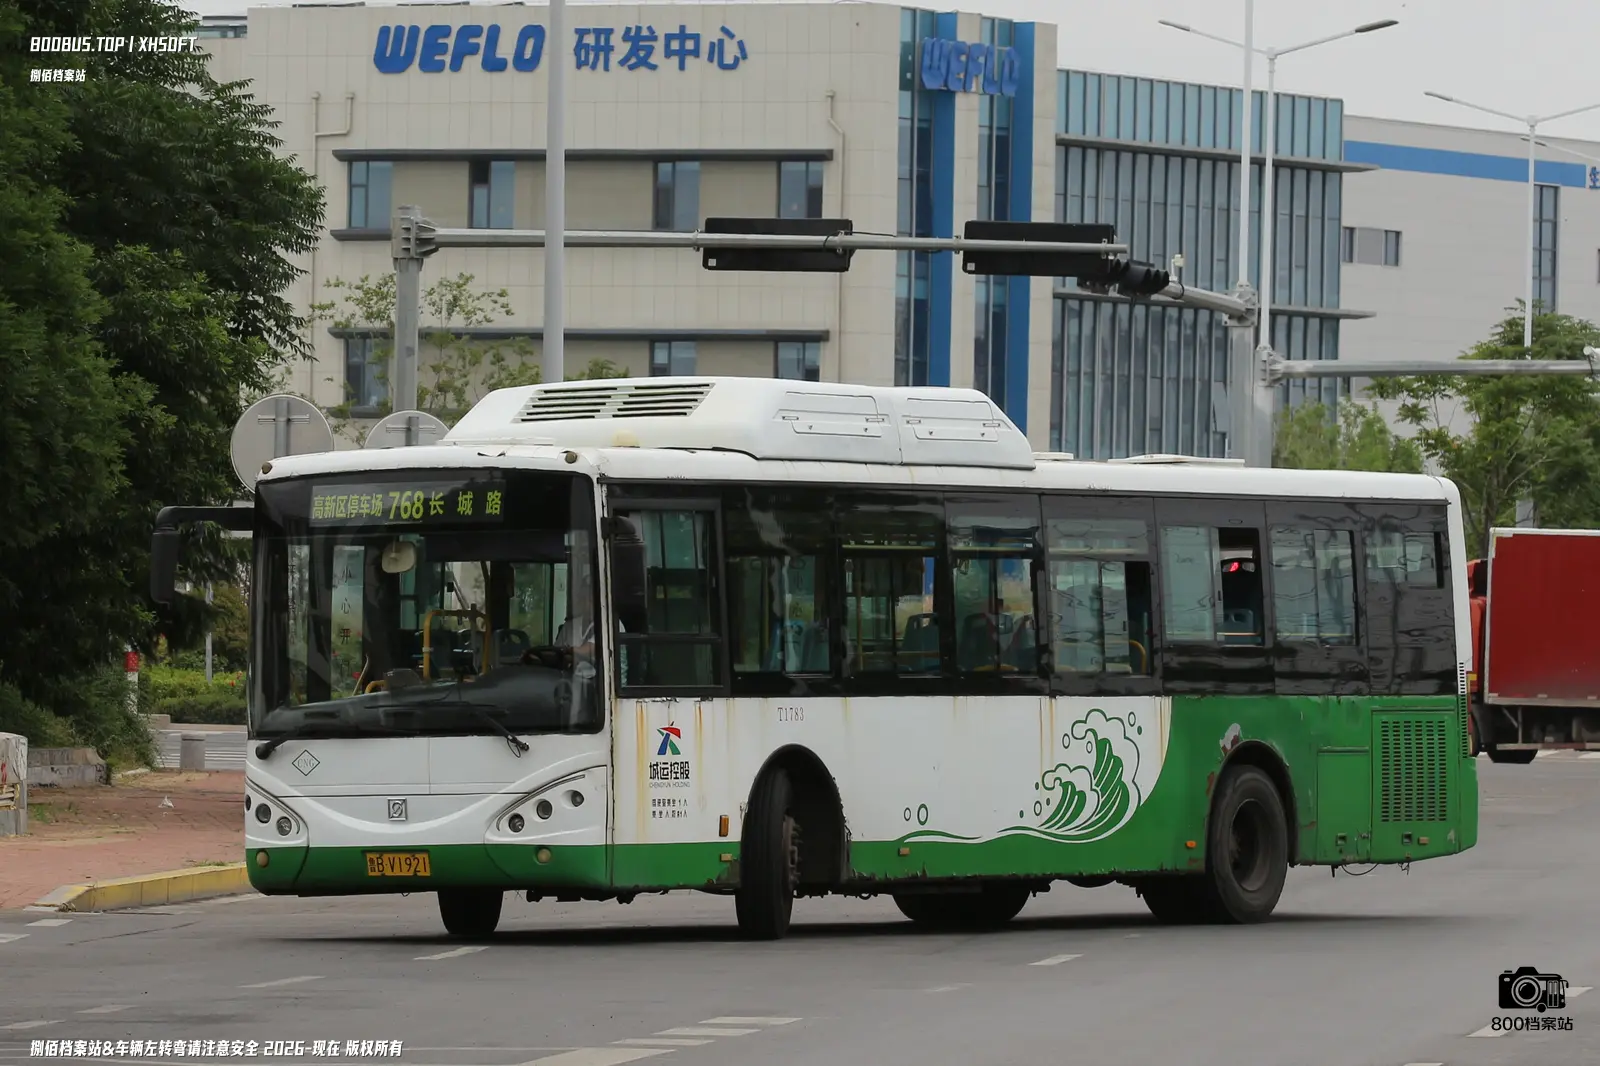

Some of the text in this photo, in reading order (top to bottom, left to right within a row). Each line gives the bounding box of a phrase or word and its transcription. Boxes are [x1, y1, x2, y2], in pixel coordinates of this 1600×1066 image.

[373, 24, 748, 74] WEFLO 研发中心
[921, 37, 1020, 97] WEFLO
[312, 490, 502, 520] 高新区停车场 768 长城路
[777, 706, 804, 721] T1783
[297, 758, 315, 768] CNG
[649, 761, 690, 780] 城运控股
